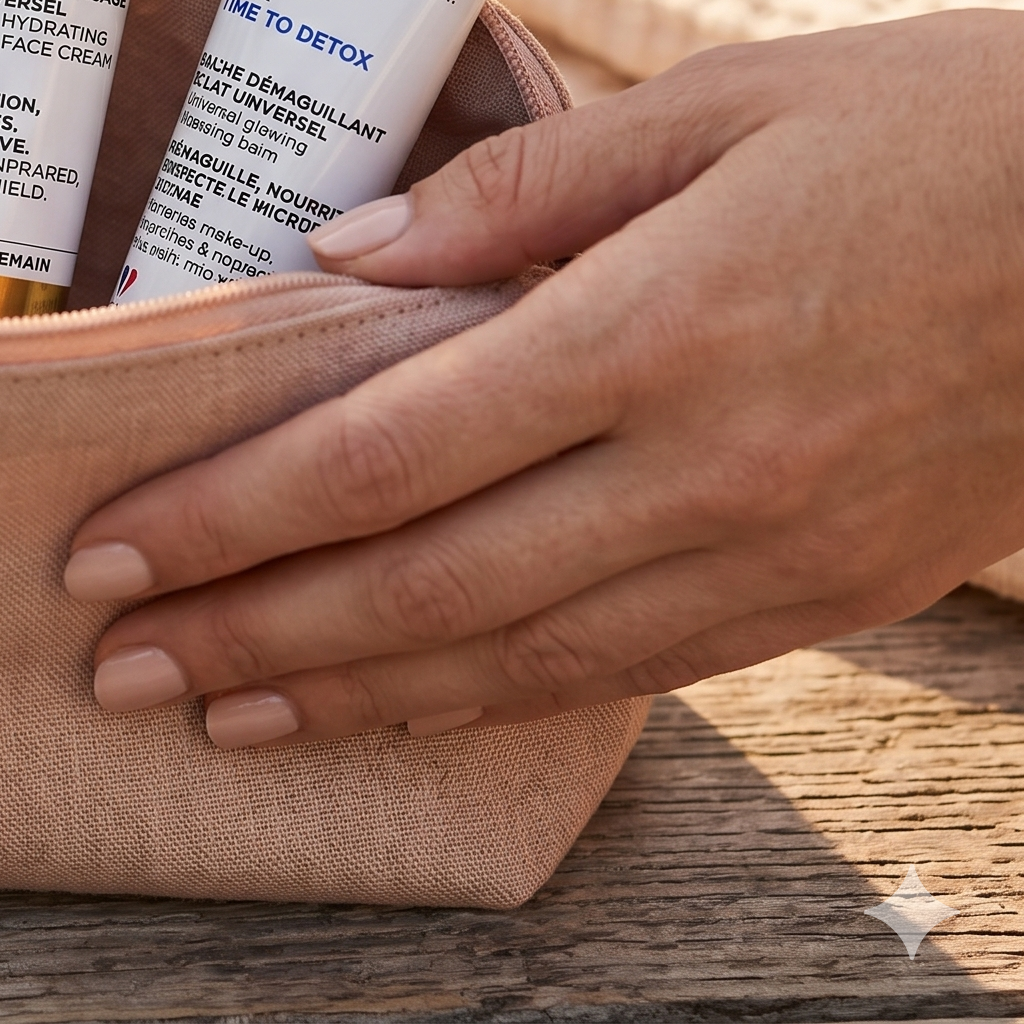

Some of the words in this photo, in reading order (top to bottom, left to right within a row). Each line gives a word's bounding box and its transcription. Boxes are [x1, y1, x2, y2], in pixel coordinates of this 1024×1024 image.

[2, 13, 107, 46] HYDRATING
[266, 10, 292, 33] TO
[296, 25, 373, 71] DETOX
[2, 35, 53, 57] FACE
[58, 45, 112, 69] CREAM
[246, 72, 386, 143] DÉMAGUILLANT
[228, 187, 250, 207] LE
[198, 242, 208, 257] &
